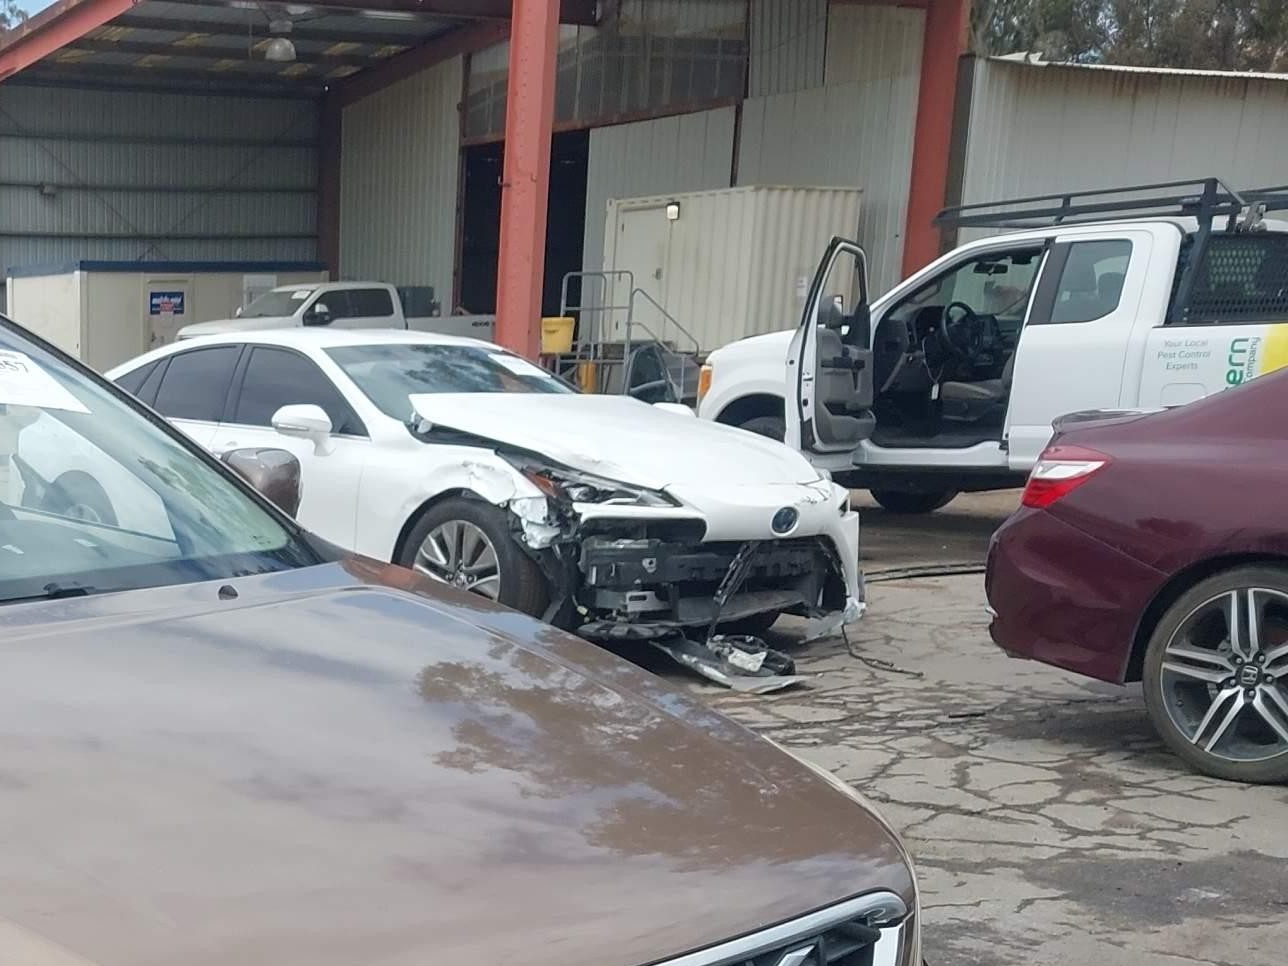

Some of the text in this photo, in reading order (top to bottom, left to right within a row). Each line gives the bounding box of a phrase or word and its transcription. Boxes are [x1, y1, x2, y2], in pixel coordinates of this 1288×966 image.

[1157, 350, 1212, 359] Pest Control
[1165, 361, 1199, 370] Experts
[1226, 338, 1249, 386] ern
[1246, 337, 1261, 378] ompany
